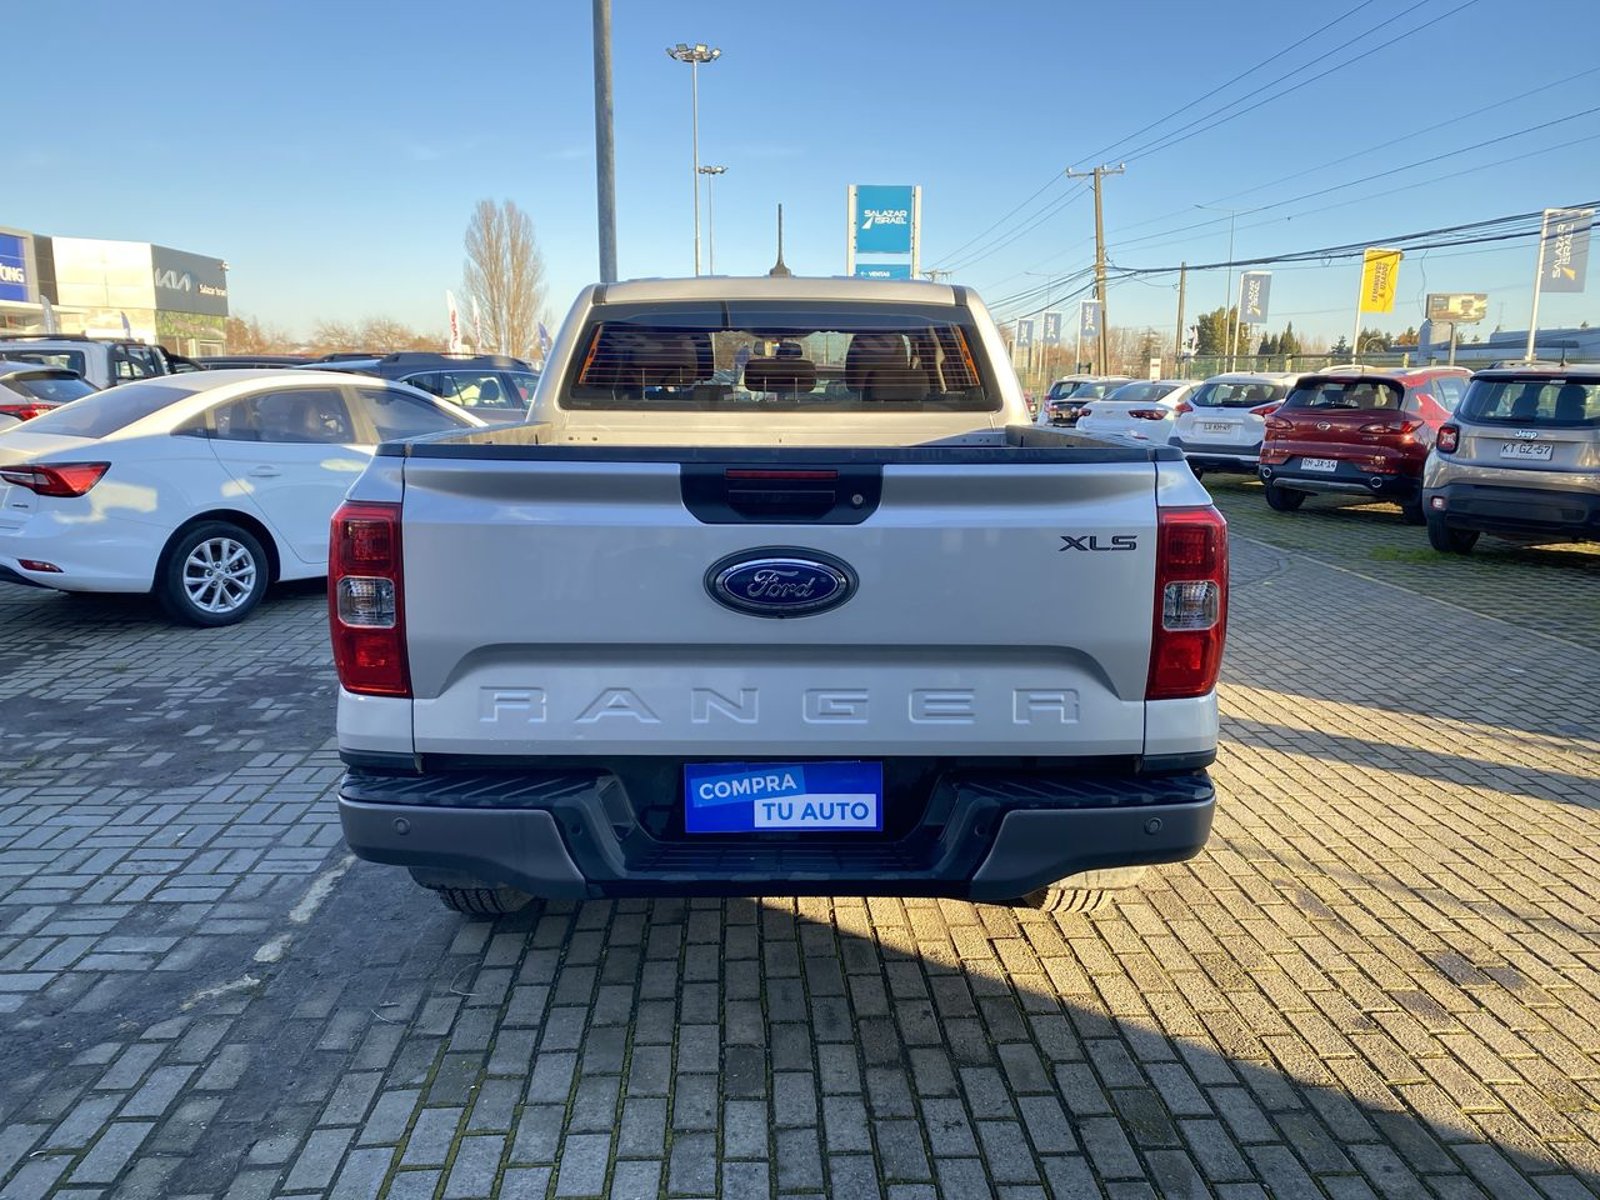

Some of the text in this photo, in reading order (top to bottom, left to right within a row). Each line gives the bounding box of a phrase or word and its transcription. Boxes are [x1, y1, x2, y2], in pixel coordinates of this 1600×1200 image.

[875, 216, 906, 224] ISRAEL
[1552, 223, 1566, 279] SALAZAR
[0, 264, 25, 283] ONG
[1515, 429, 1538, 440] Jeep
[1058, 535, 1138, 551] XLS
[747, 569, 816, 598] Ford
[479, 686, 1081, 725] RANGER
[699, 773, 798, 800] COMPRA
[762, 802, 869, 821] TU AUTO
